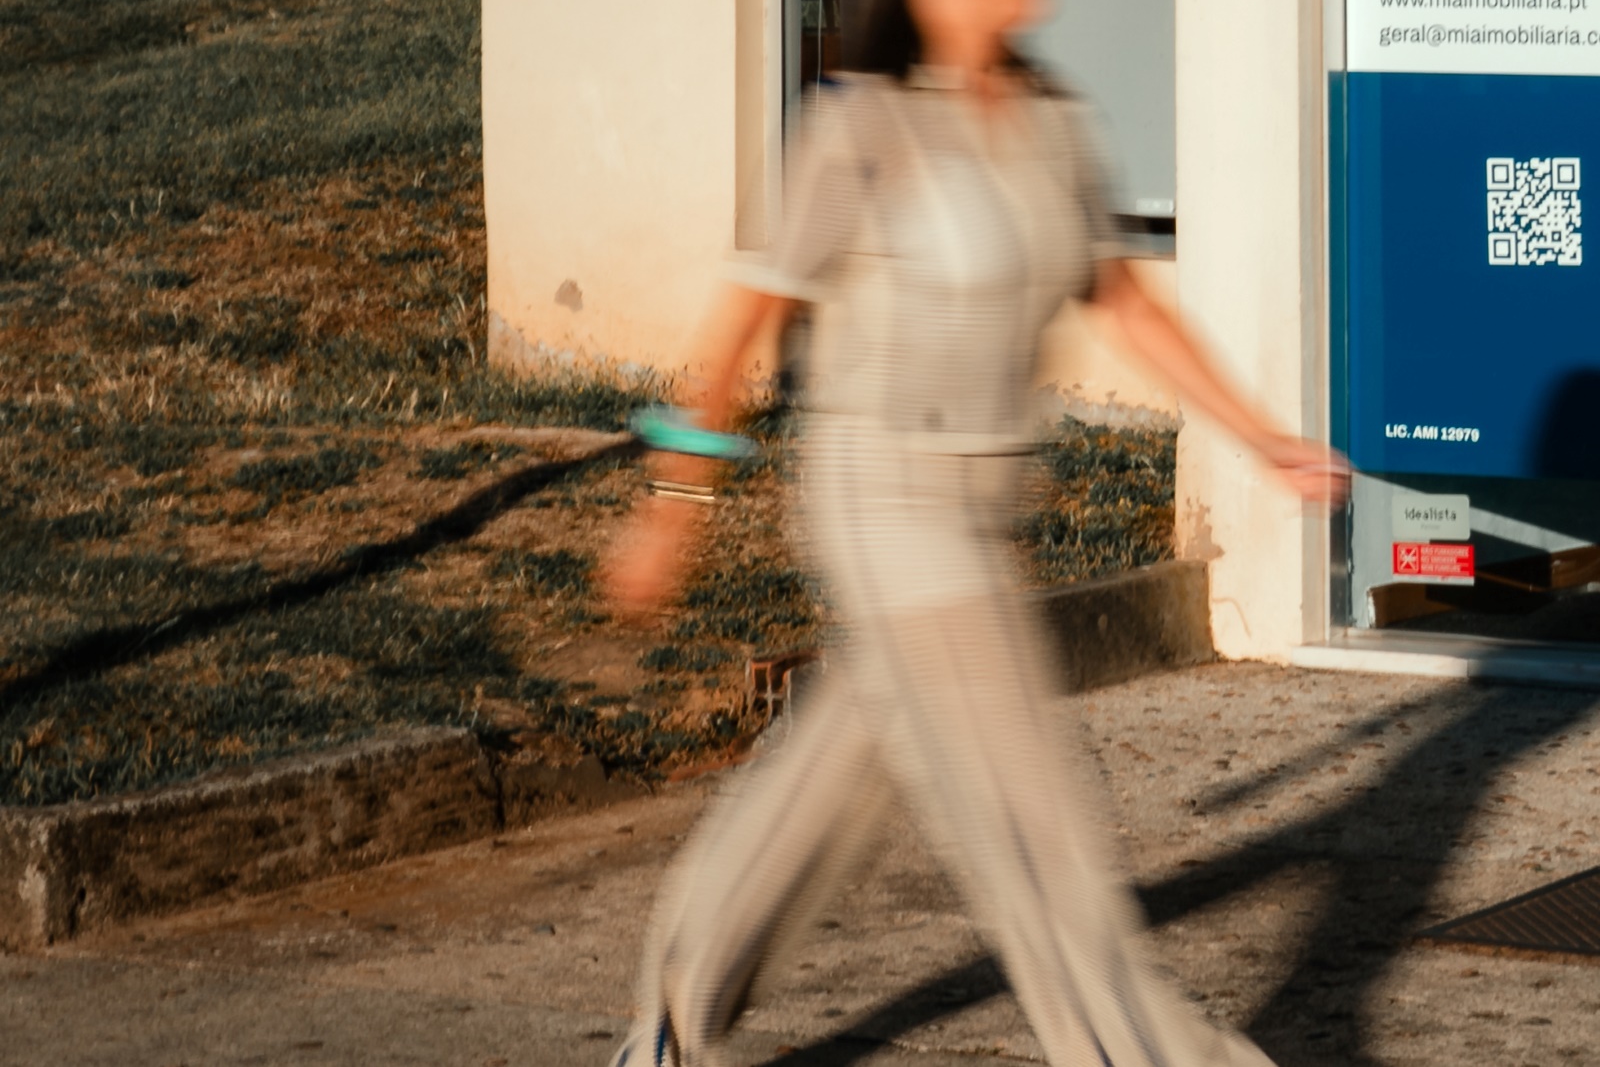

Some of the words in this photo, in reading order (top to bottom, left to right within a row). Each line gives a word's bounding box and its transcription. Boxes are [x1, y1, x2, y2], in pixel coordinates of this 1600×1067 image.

[1385, 423, 1411, 439] LIC.
[1412, 424, 1438, 441] AMI
[1404, 506, 1457, 522] idealista
